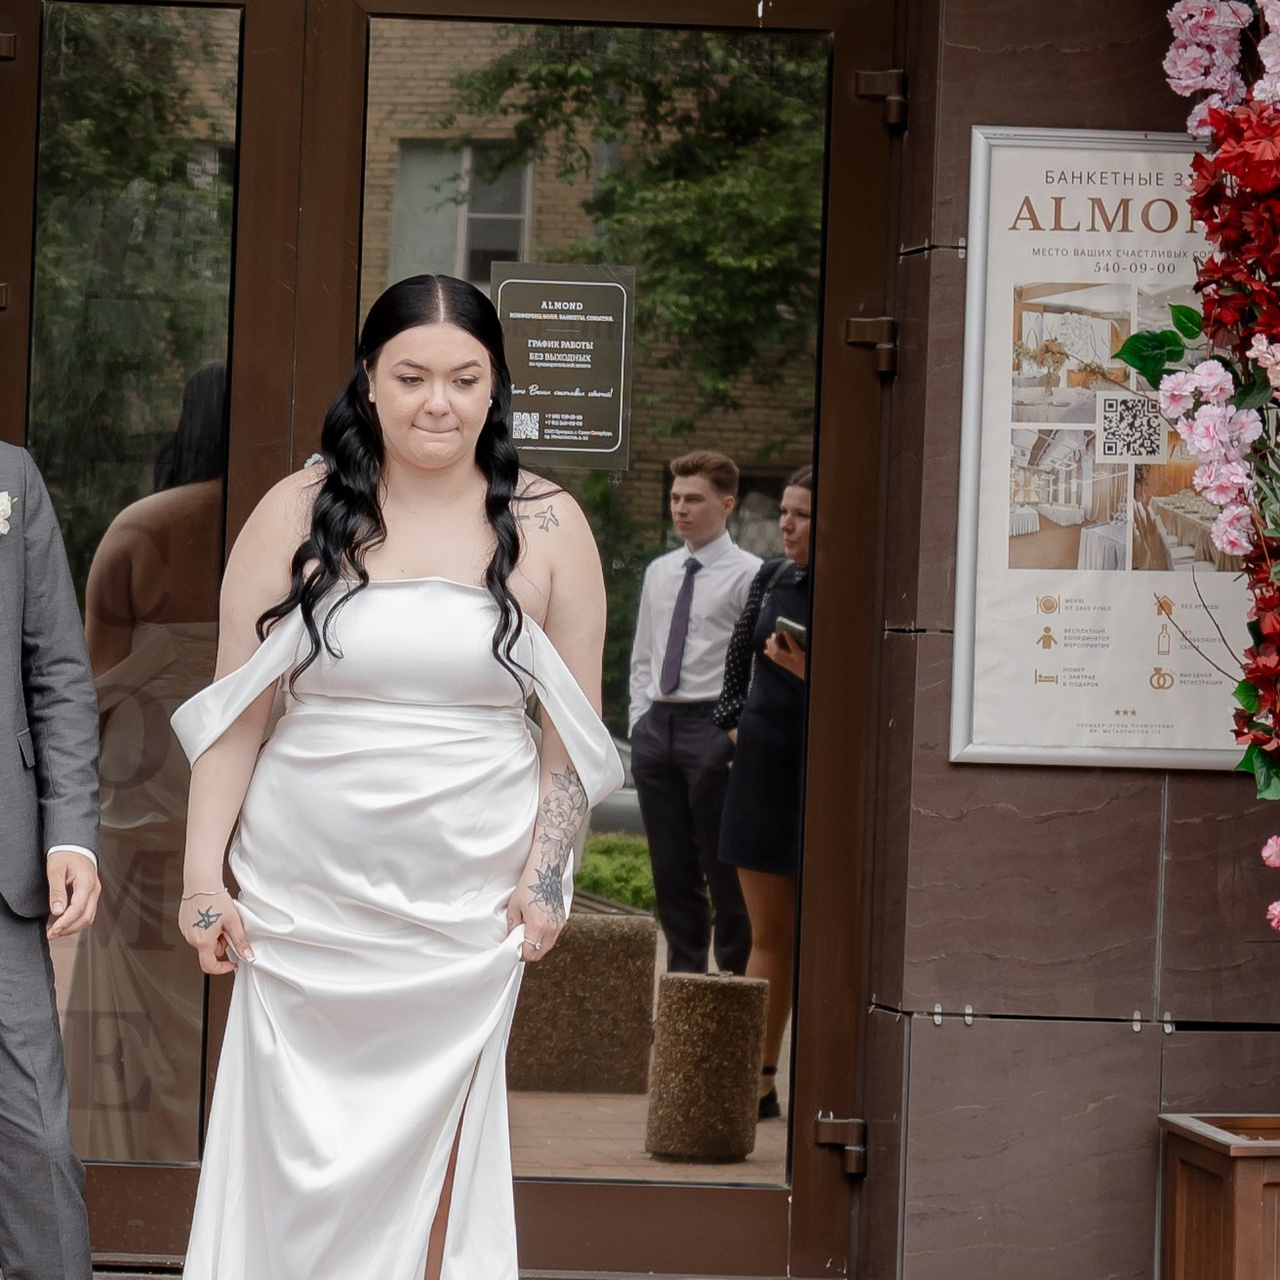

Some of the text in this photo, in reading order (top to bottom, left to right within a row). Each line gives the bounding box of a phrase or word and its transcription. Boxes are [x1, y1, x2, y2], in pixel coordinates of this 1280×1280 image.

[1045, 170, 1165, 187] БАНКЕТНЫЕ
[1008, 196, 1202, 234] ALMO
[1032, 247, 1069, 257] МЕСТО
[1073, 248, 1112, 258] ВАШИХ
[1116, 249, 1188, 259] СЧАСТЛИВЫХ
[1094, 261, 1176, 274] 540-09-00
[541, 300, 584, 311] ALMOND
[528, 339, 594, 350] ГРАФИК РАБОТЫ
[529, 352, 592, 363] БЕЗ ВЫХОДНЫХ
